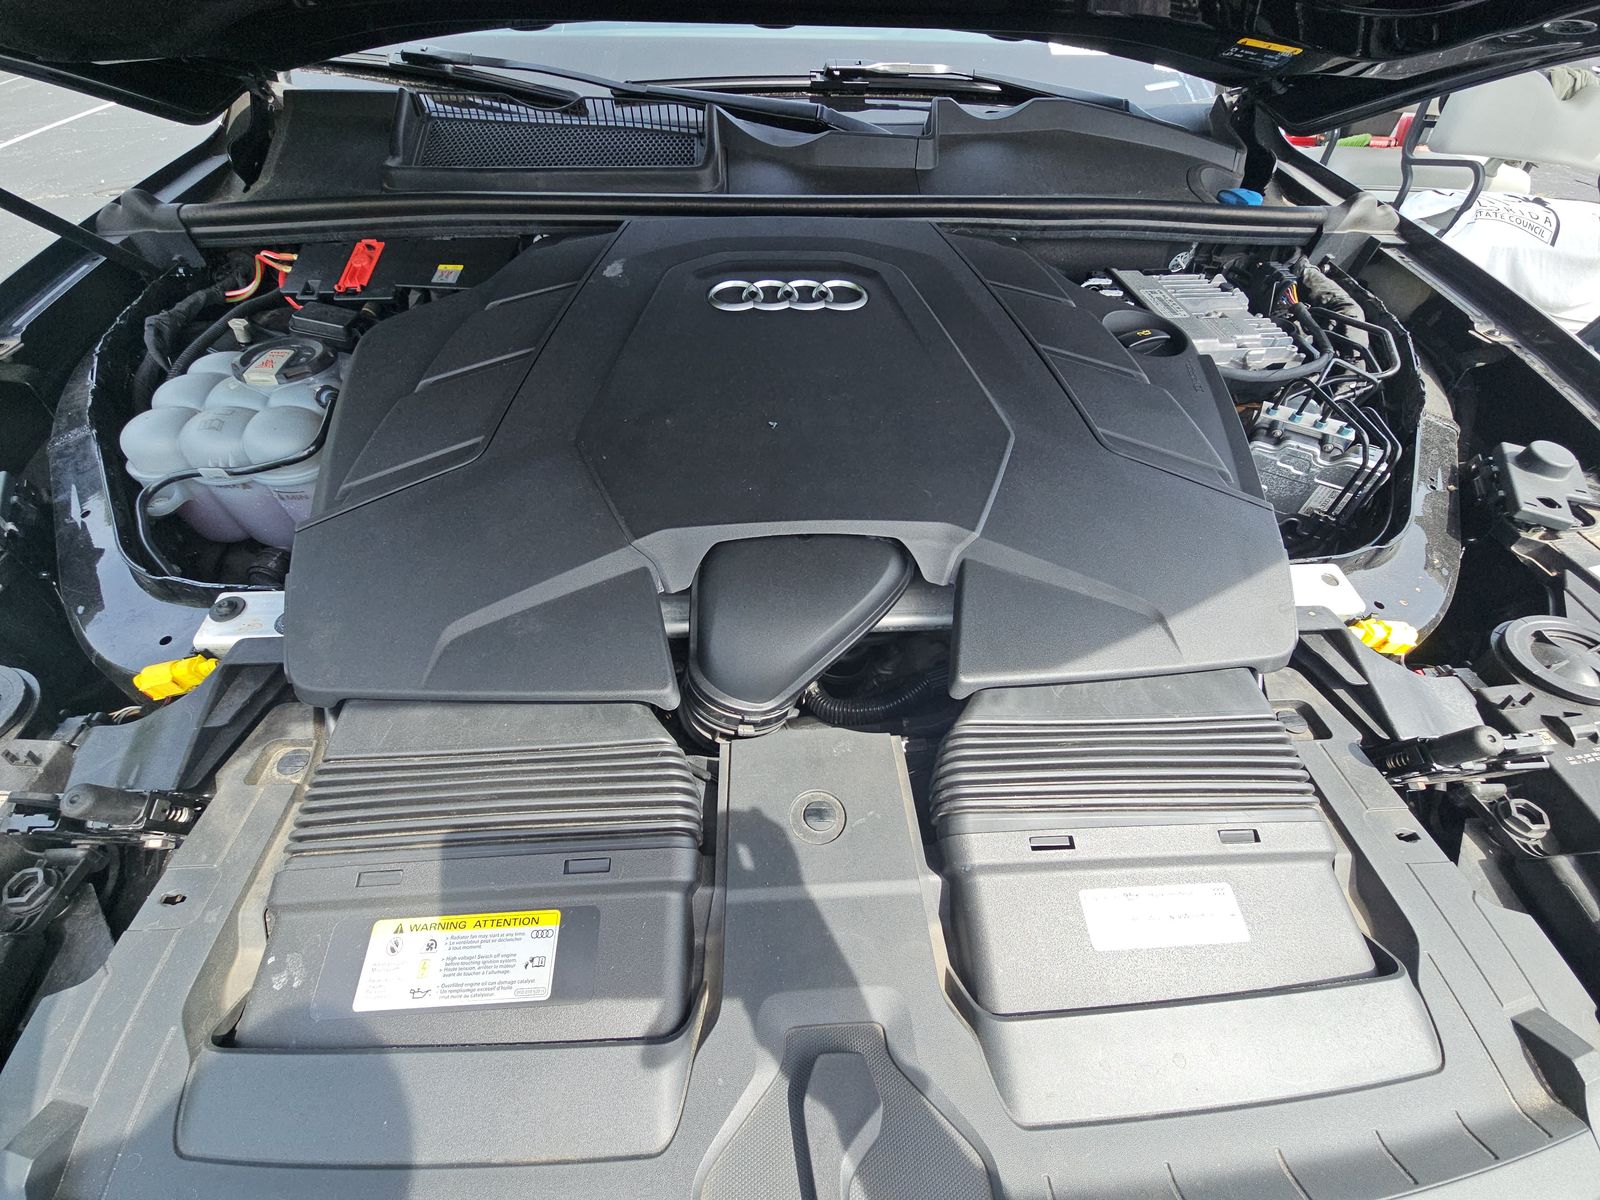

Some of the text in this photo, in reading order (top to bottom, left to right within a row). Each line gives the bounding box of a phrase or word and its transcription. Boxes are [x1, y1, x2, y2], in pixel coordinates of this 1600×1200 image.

[1508, 215, 1545, 238] COUNCIL
[409, 916, 540, 932] WARNING ATTENTION
